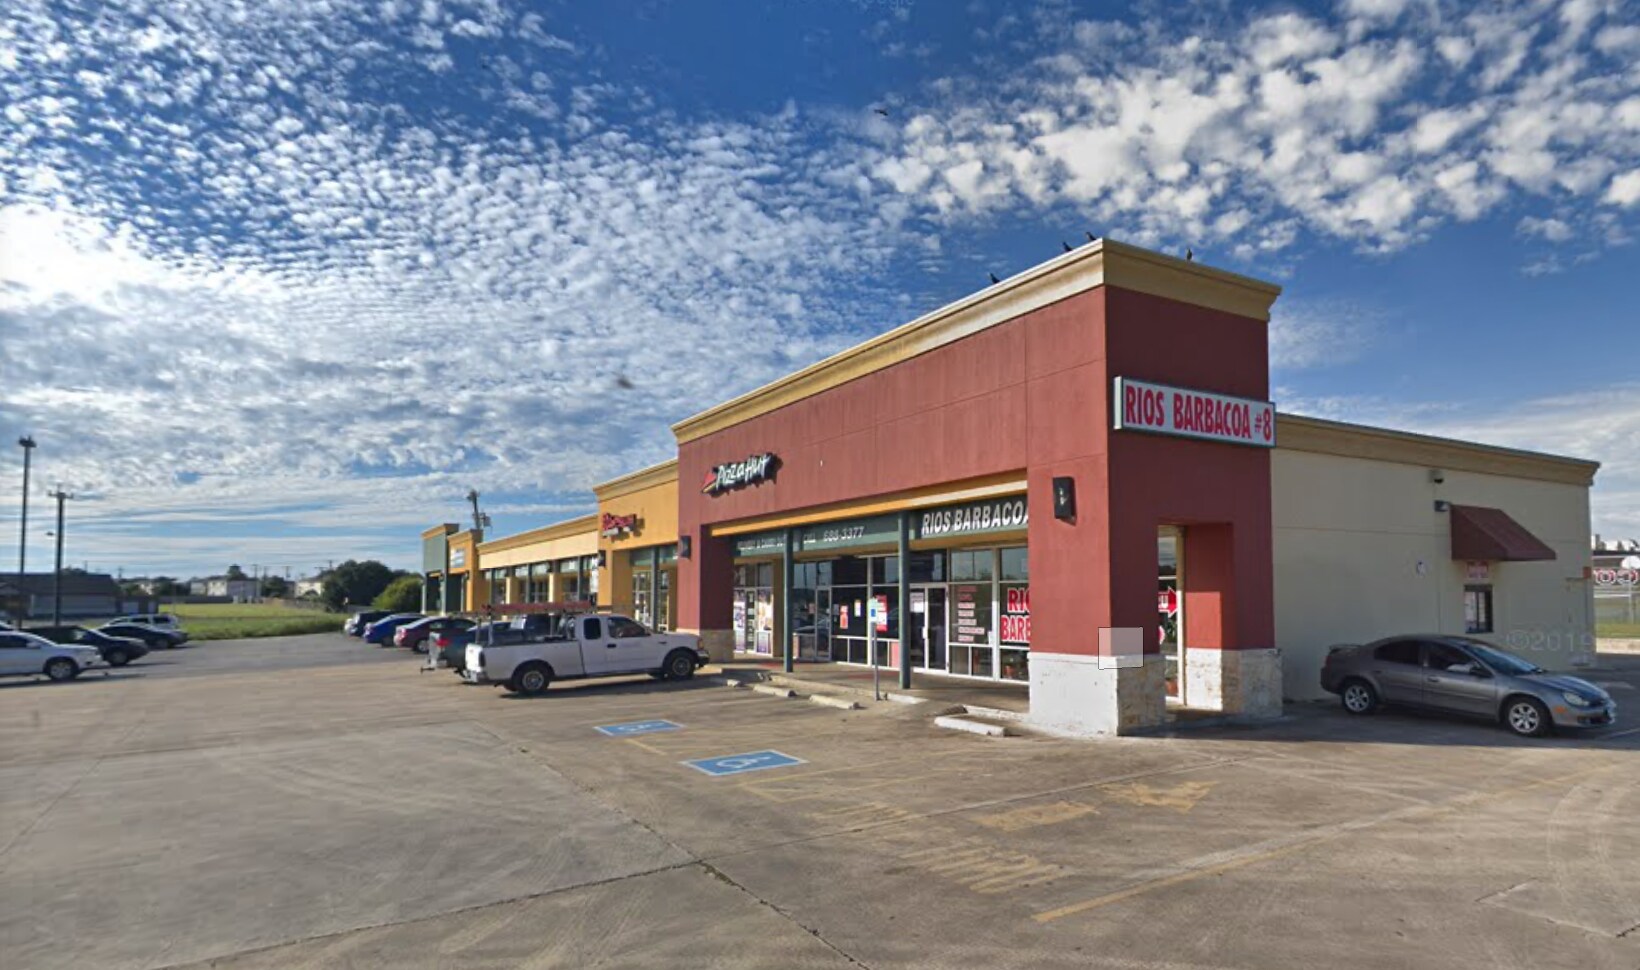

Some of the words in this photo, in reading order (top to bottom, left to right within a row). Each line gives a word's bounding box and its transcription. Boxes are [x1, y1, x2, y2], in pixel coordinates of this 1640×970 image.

[1125, 385, 1165, 427] RIOS
[1173, 392, 1252, 439] BARBACOA
[1254, 407, 1272, 442] #8
[921, 511, 951, 535] RIOS
